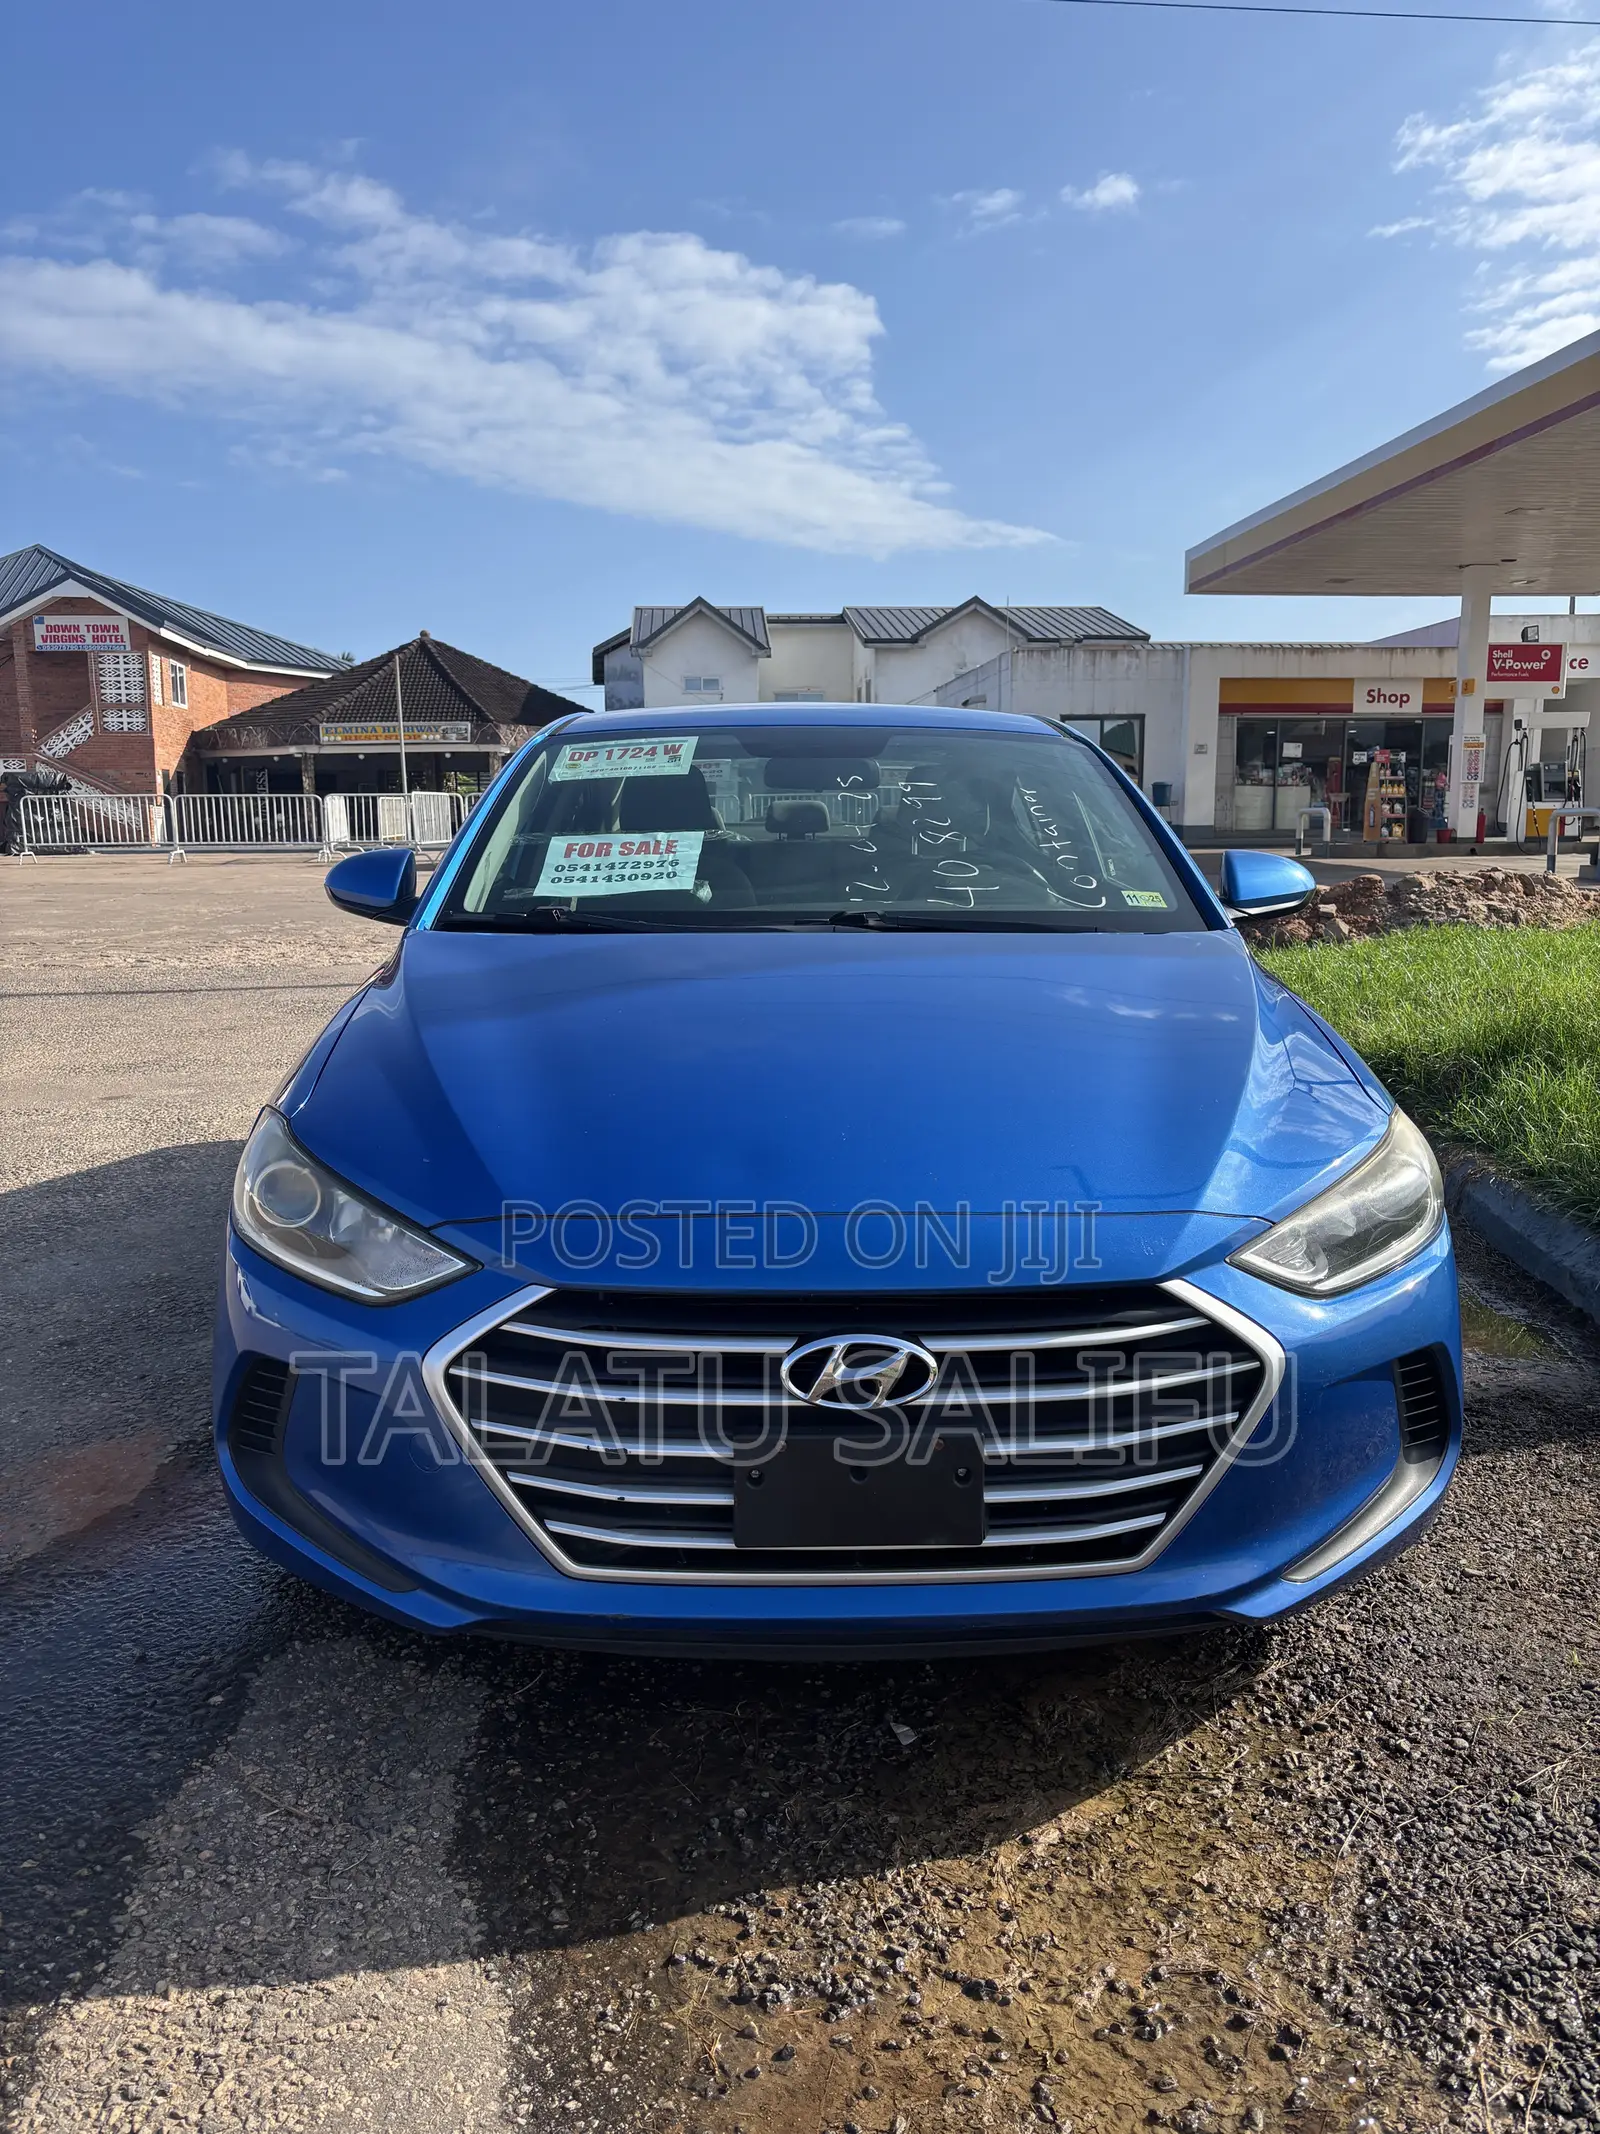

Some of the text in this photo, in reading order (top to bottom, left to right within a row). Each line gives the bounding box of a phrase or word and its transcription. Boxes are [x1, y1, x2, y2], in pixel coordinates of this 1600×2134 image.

[45, 624, 119, 633] DOWN TOWN
[41, 634, 126, 643] VIRGINS HOTEL
[1492, 650, 1513, 659] Shell
[1492, 659, 1547, 670] V-Power
[1569, 658, 1589, 670] ce
[1366, 688, 1411, 708] Shop
[324, 726, 378, 734] ELMINA
[568, 744, 684, 762] DP 1724 W
[563, 839, 679, 858] FOR SALE
[554, 859, 680, 873] 0541472976
[550, 871, 678, 884] 0541430920
[1126, 894, 1162, 904] 11 25
